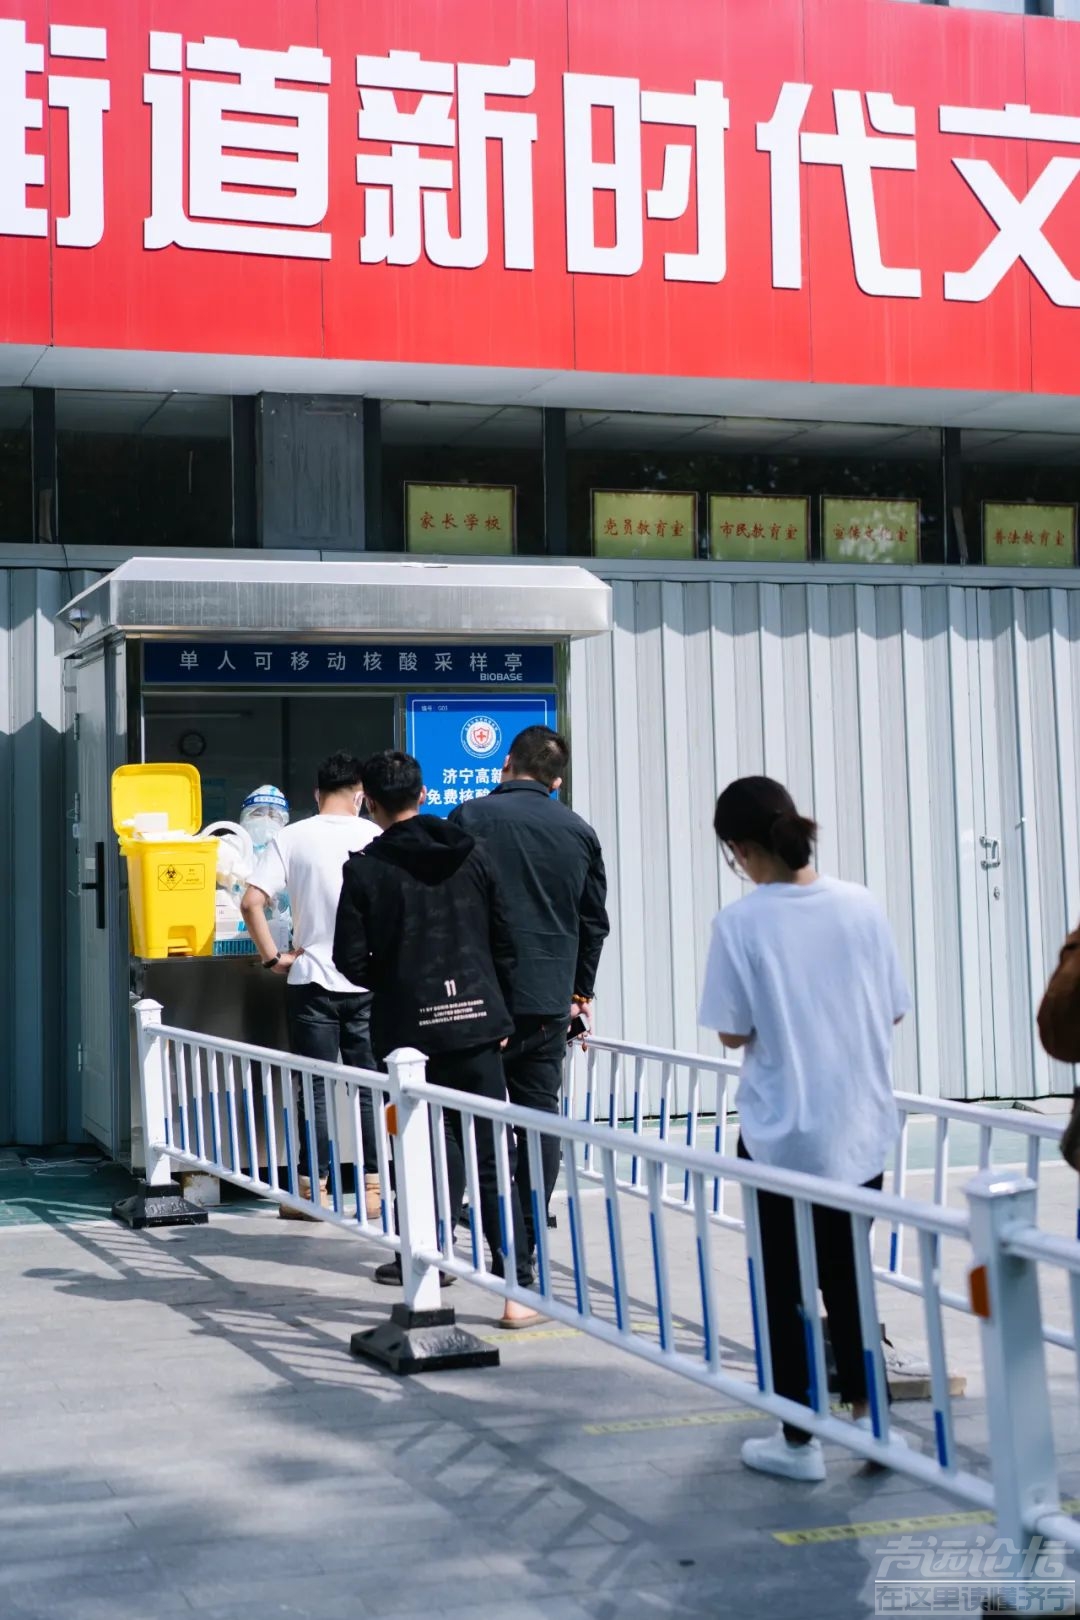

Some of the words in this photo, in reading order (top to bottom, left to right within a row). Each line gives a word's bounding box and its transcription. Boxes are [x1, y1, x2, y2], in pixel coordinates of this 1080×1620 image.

[0, 19, 1080, 308] 街道新时代文
[419, 512, 501, 531] 家长学校
[603, 516, 685, 538] 党员教育室
[719, 520, 798, 541] 市民教育室
[179, 650, 522, 672] 单人可移动核酸采样亭
[480, 673, 523, 681] BIOBASE
[444, 979, 457, 997] 11
